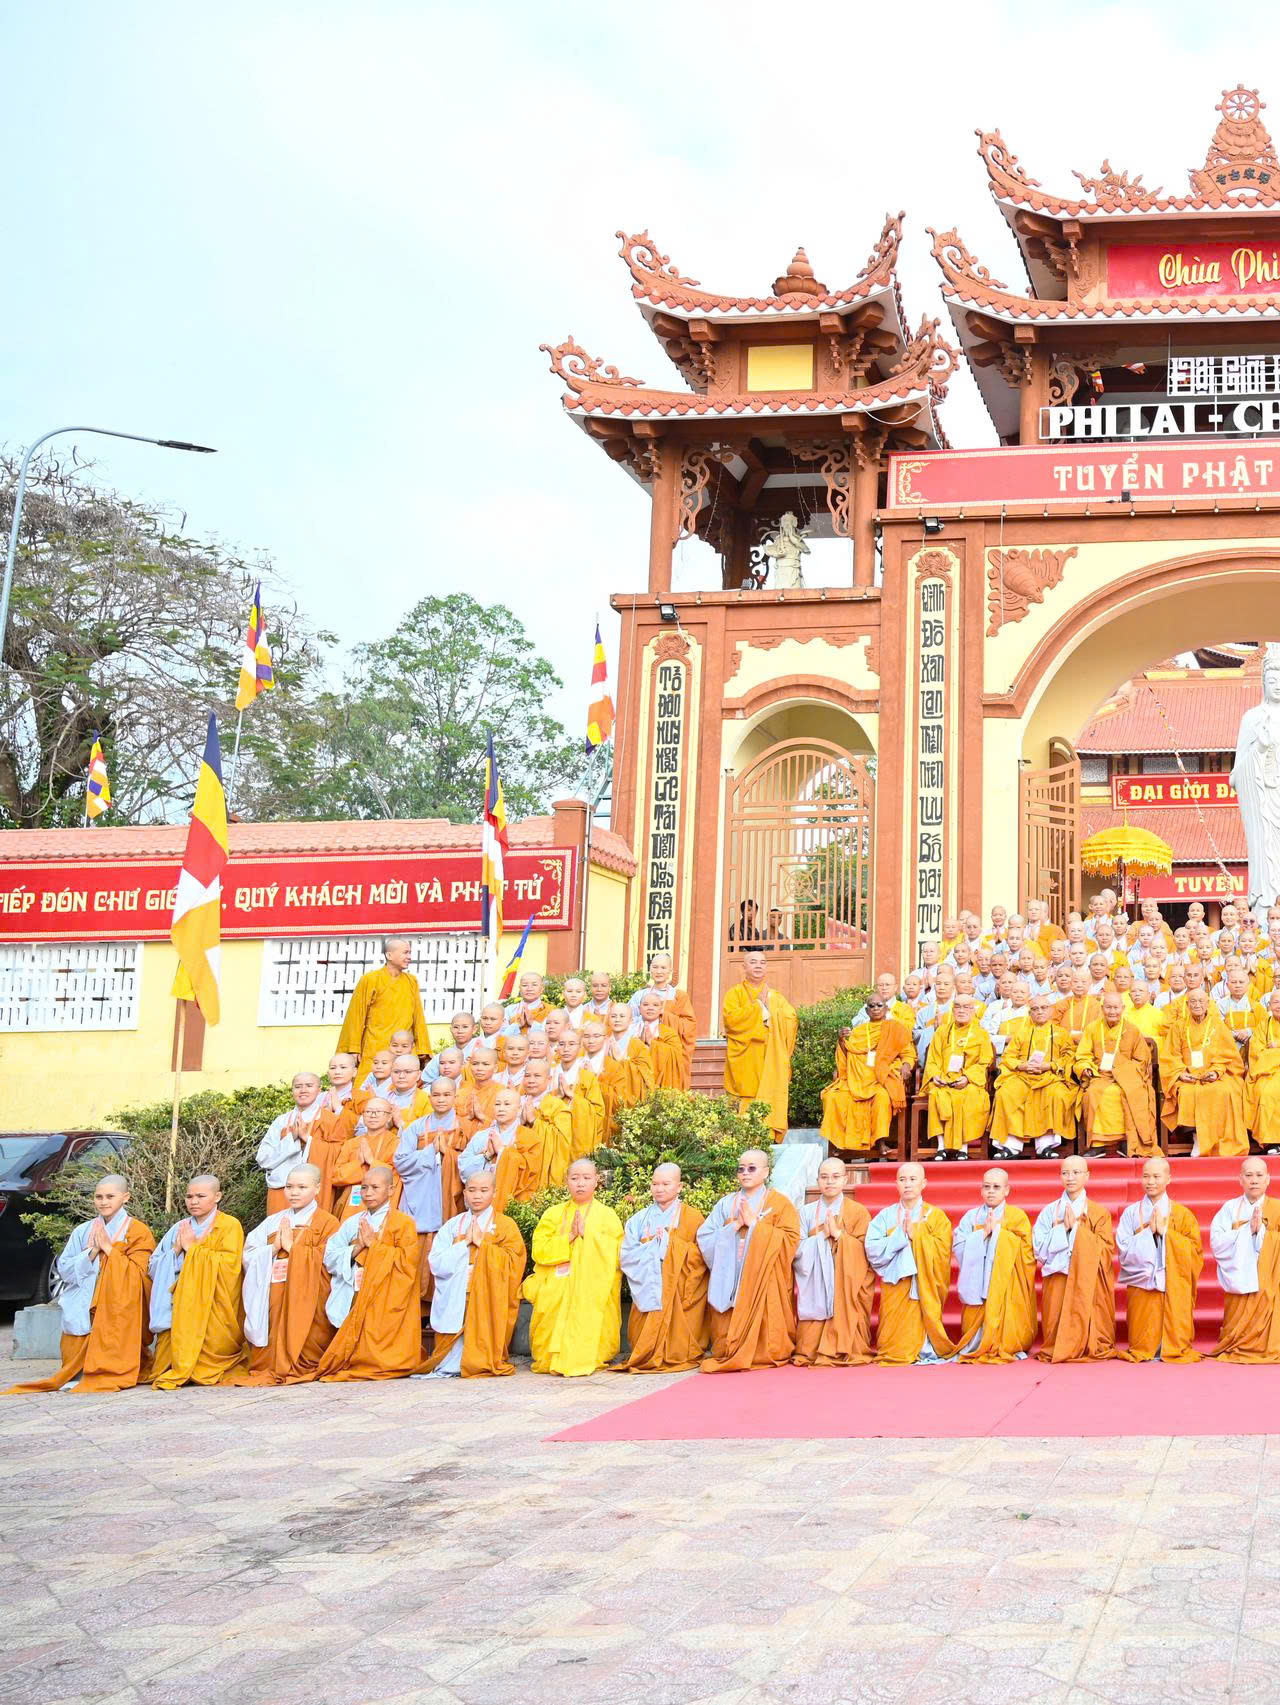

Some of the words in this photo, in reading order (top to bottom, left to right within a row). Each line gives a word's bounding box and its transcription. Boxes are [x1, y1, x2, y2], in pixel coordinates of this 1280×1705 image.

[1158, 253, 1222, 288] Chùa
[1050, 405, 1116, 437] PHI
[1130, 403, 1196, 435] LAI
[1053, 453, 1164, 491] TUYỂN
[1181, 455, 1273, 492] PHẬT
[1130, 784, 1163, 802] ĐẠI
[1169, 780, 1210, 799] GIỚI
[40, 887, 88, 912] ĐÓN
[94, 887, 141, 911] CHƯ
[234, 882, 279, 912] QUÝ
[284, 880, 362, 907] KHÁCH
[368, 878, 409, 905] MỜI
[415, 877, 443, 903] VÀ
[514, 873, 544, 900] TỬ
